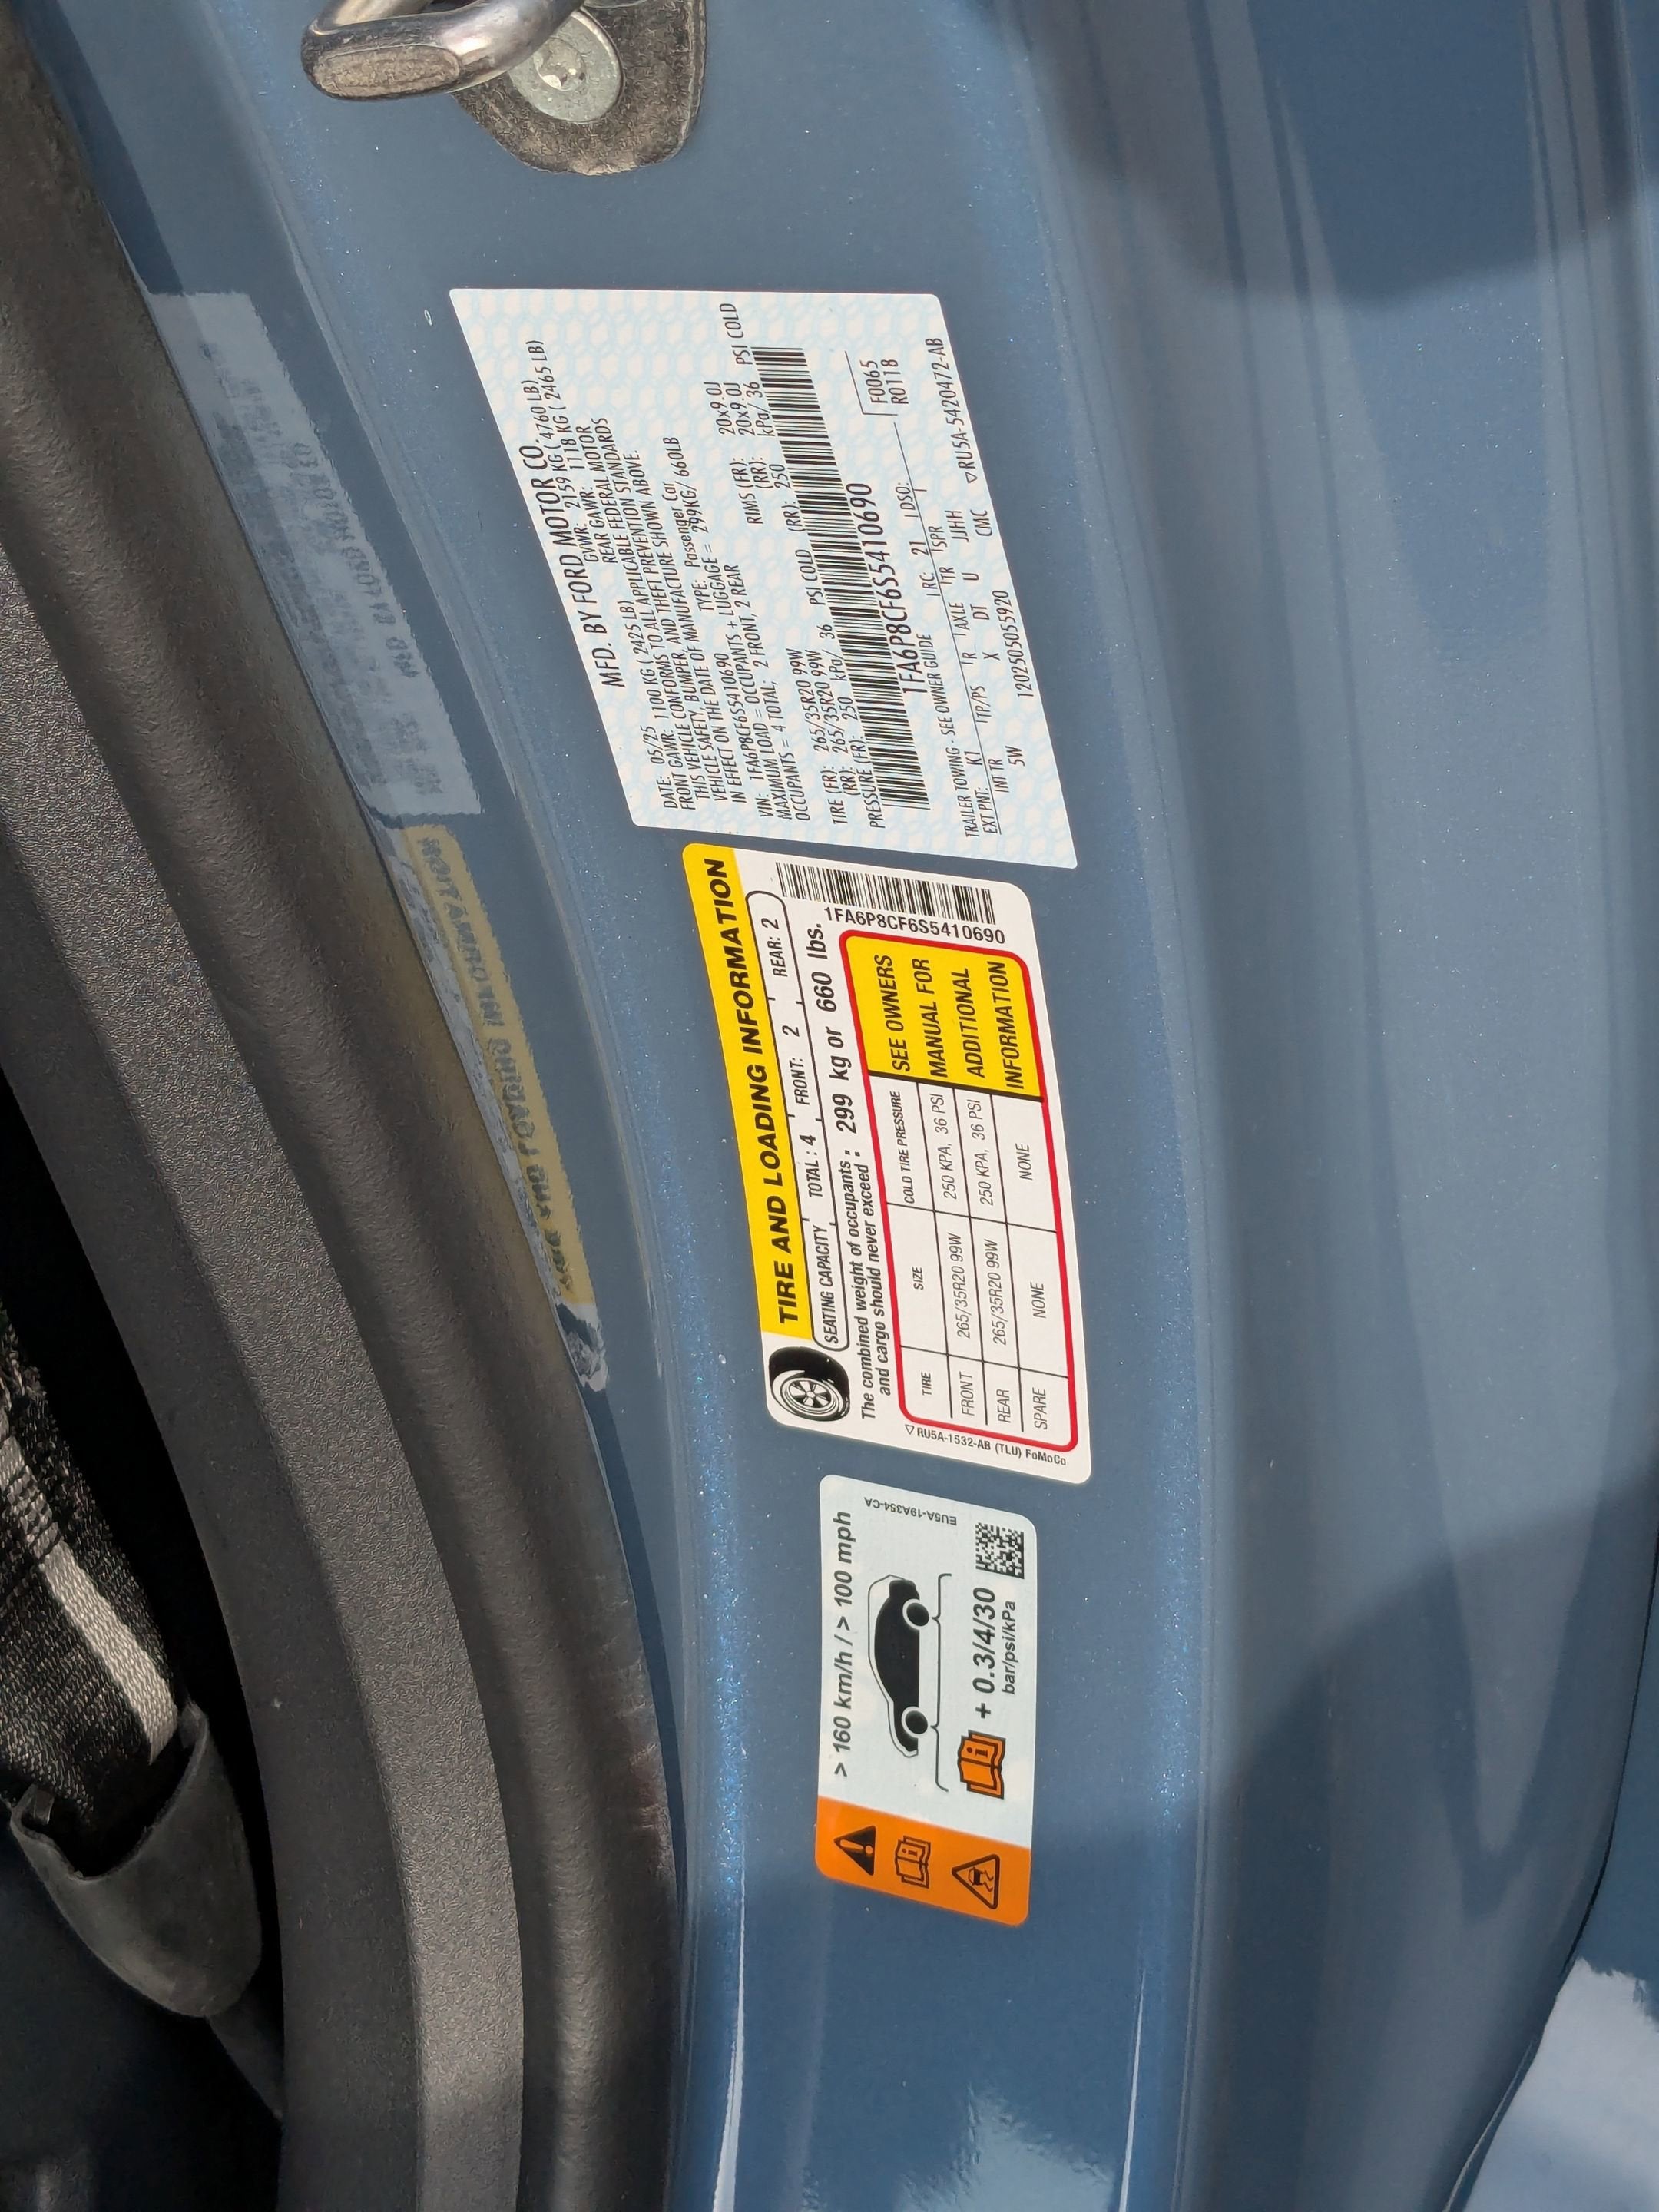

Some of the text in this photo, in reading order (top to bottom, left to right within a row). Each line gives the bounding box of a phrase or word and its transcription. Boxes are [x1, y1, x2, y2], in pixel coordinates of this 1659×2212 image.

[718, 302, 806, 533] (RR): 250 kPa/ 36 PSI COLD
[722, 382, 775, 490] (RR): 20x9.0J
[859, 359, 889, 405] F0065
[879, 358, 910, 406] R0118
[924, 337, 977, 470] RU5A-5420472-AB
[519, 379, 601, 563] GVWR: 2159 KG 4760 LB)
[525, 339, 619, 565] REAR GAWR: 1118 KG 2465 LB)
[702, 381, 765, 525] RIMS (FR): 20x9.0J
[894, 480, 918, 512] DSO:
[518, 439, 627, 688] MFD. BY FORD MOTOR CO.
[661, 480, 716, 613] TYPE: Passenger Car
[908, 541, 939, 591] RC: 21
[927, 525, 949, 548] SPR
[969, 508, 994, 538] CMC
[661, 436, 793, 821] MAXIMUM LOAD OCCUPANTS LUGGAGE 299KG/ 660LB
[844, 482, 929, 694] 1FA6P8CF6S5410690
[947, 601, 971, 631] AXLE
[793, 548, 886, 830] PRESSURE (FR): 250 kPa/ 36 PSI COLD
[991, 589, 1035, 698] 1202505055920
[616, 599, 697, 811] FRONT GAWR: 1100 KG 2425 LB)
[712, 651, 775, 818] VIN: 1FA6P8CF6S5410690
[784, 647, 849, 826] TIRE (FR): 265/35R20 99W
[803, 648, 863, 797] (RR): 265/35R20 99W
[915, 633, 981, 838] TRAILER TOWING SEE OWNER GUIDE
[969, 684, 993, 719] TP/PS
[639, 725, 680, 810] DATE: 05/25
[962, 750, 999, 835] EXT PNT: K1
[760, 916, 789, 979] REAR: 2
[823, 906, 1006, 945] 1FA6P8CF6S5410690
[780, 1024, 811, 1106] FRONT: 2
[805, 922, 858, 1135] 299 kg or 660 lbs.
[873, 953, 912, 1073] SEE OWNERS
[910, 957, 949, 1079] MANUAL FOR
[950, 967, 986, 1079] ADDITIONAL
[985, 960, 1025, 1091] INFORMATION
[703, 857, 800, 1325] TIRE AND LOADING INFORMATION
[798, 1134, 824, 1199] TOTAL 4
[889, 1090, 916, 1205] COLD TIRE PRESSURE
[929, 1092, 958, 1200] 250 KPA, 36 PSI
[965, 1098, 995, 1207] 250 KPA, 36 PSI
[1014, 1142, 1034, 1181] NONE
[811, 1224, 839, 1345] SEATING CAPACITY
[836, 1160, 876, 1420] The combined weight of occupants
[853, 1162, 892, 1397] and cargo should never exceed
[911, 1266, 925, 1292] SIZE
[947, 1231, 972, 1339] 265/35R20 99W
[983, 1237, 1009, 1346] 265/35R20 99W
[1028, 1281, 1047, 1320] NONE
[919, 1371, 933, 1396] TIRE
[958, 1370, 975, 1417] FRONT
[995, 1388, 1012, 1424] REAR
[1031, 1386, 1048, 1431] SPARE
[916, 1426, 1067, 1467] RU5A-1532-AB (TLU) FoMoCo
[863, 1496, 958, 1527] EU5A-19A354-CA
[832, 1511, 856, 1778] > 160 km/h / > 100 mph
[971, 1586, 997, 1720] + 0.3/4/30
[1000, 1600, 1019, 1696] bar/psi/kPa
